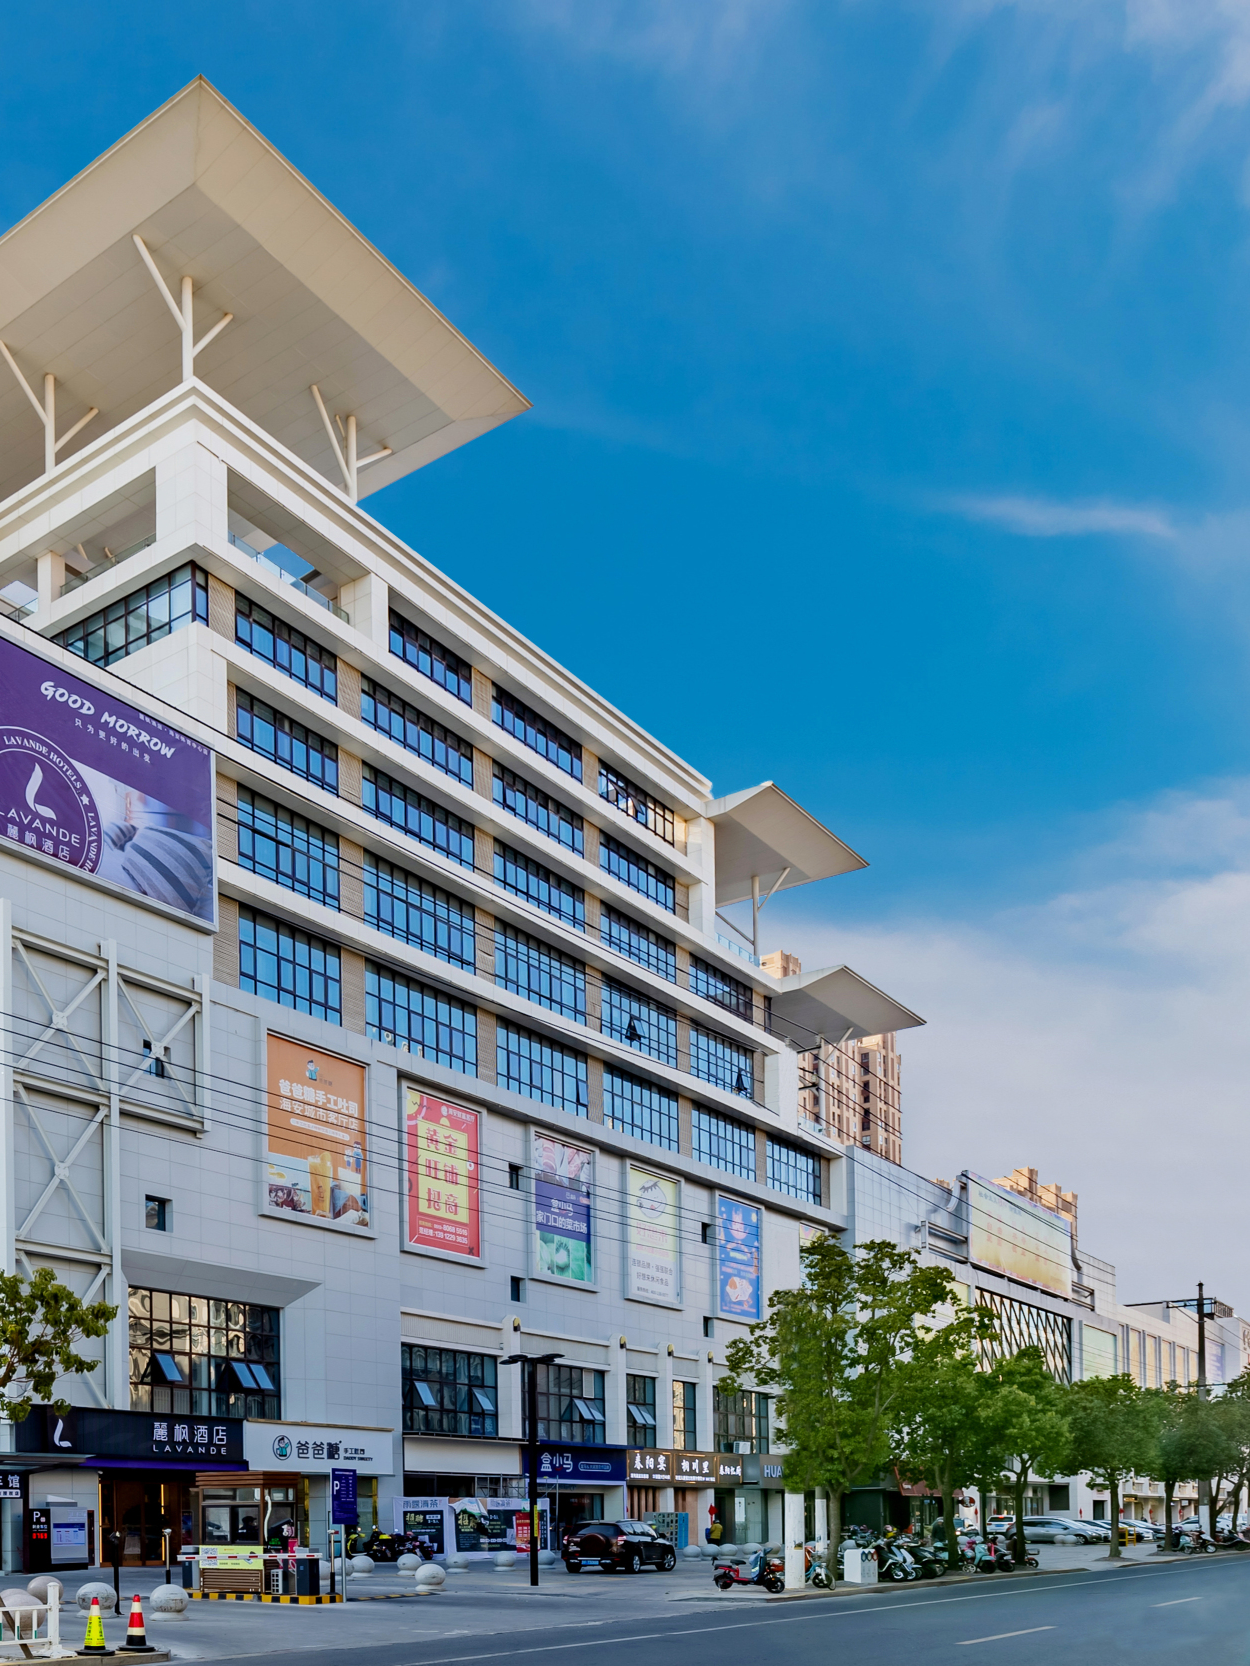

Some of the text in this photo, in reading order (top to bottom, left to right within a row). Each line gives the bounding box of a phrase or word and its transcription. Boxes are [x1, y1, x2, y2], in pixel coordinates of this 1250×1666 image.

[40, 680, 176, 759] GOOD MORROW
[74, 717, 151, 764] 只为更好的出发
[3, 735, 83, 789] LAVANDE HOTELS
[6, 823, 70, 862] 麗枫酒店
[278, 1078, 359, 1117] 爸爸糖手工吐司
[279, 1097, 359, 1133] 海安城市客厅店
[425, 1126, 458, 1157] 黄金
[425, 1157, 460, 1187] 旺铺
[426, 1186, 460, 1216] 招商
[536, 1210, 588, 1234] 家门口的菜市场
[152, 1422, 227, 1445] 麗枫酒店
[152, 1444, 227, 1455] LAVANDE
[295, 1440, 340, 1460] 爸爸糖
[540, 1452, 574, 1472] 盒小马
[764, 1465, 784, 1478] HUA
[333, 1480, 340, 1495] P
[33, 1511, 41, 1522] P
